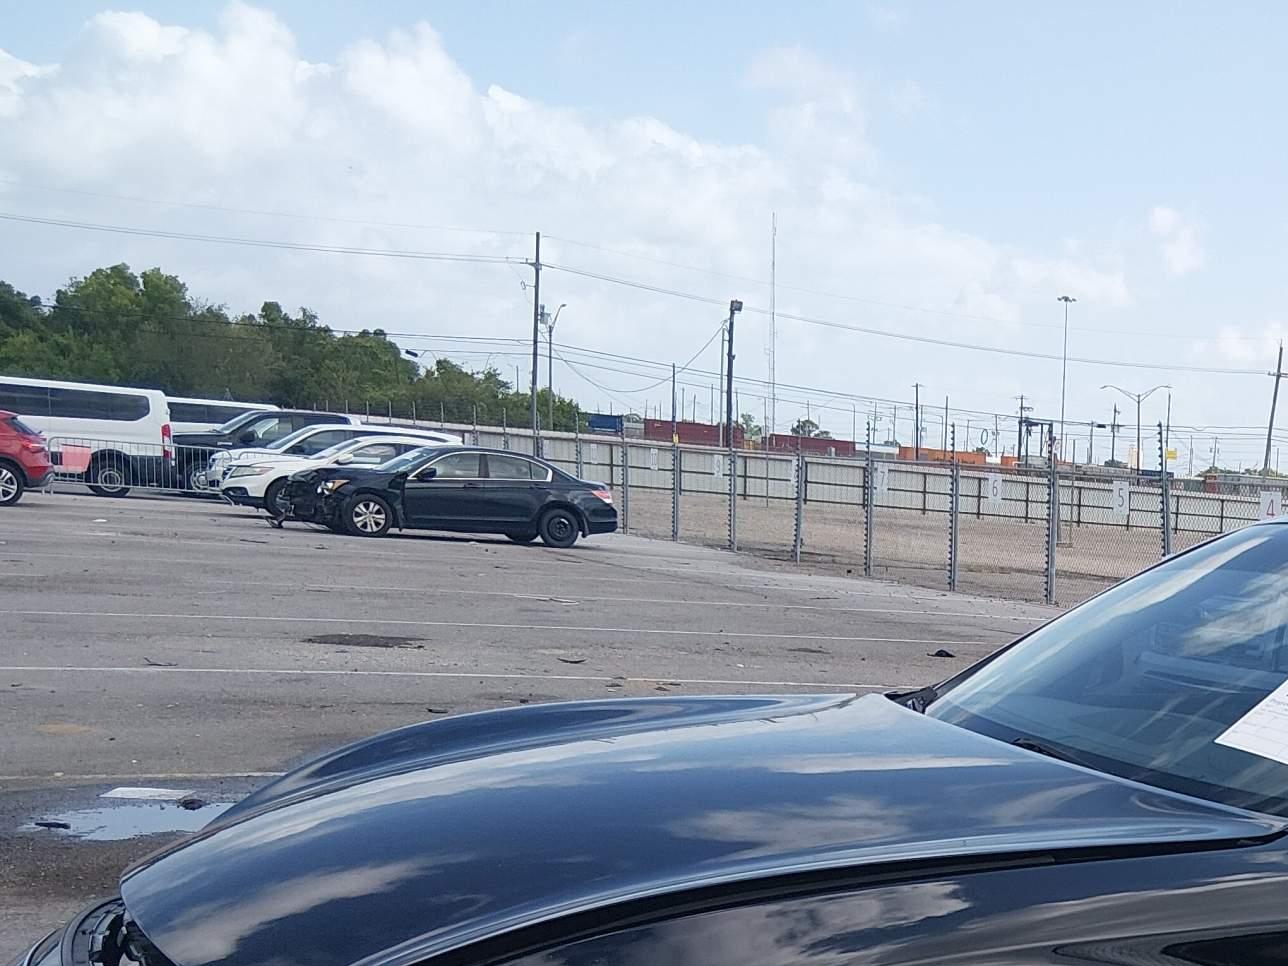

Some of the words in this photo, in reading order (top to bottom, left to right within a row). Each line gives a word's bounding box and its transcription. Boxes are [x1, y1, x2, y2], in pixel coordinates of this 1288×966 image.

[992, 479, 999, 497] 6
[1117, 487, 1125, 508] 5
[1266, 498, 1276, 518] 4
